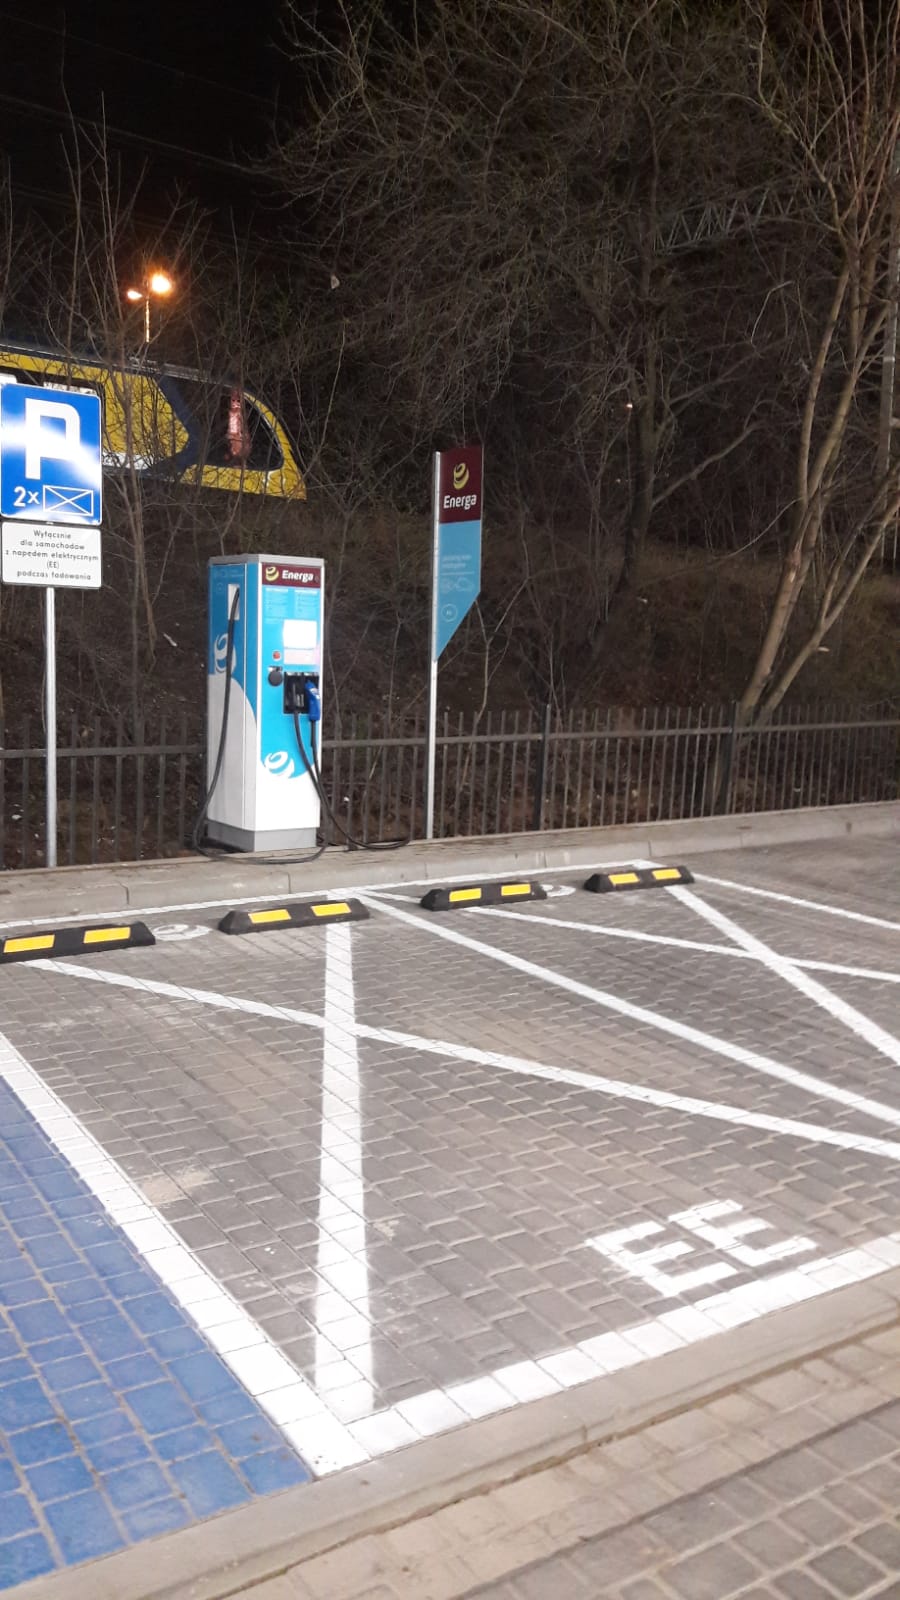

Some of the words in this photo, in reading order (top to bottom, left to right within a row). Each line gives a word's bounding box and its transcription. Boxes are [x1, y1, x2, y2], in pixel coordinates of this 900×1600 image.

[25, 398, 80, 480] P
[13, 485, 40, 507] 2x
[443, 494, 477, 510] Energa
[46, 560, 60, 569] (EE)
[51, 552, 99, 562] elektrycznym
[17, 570, 48, 578] podczas
[282, 569, 314, 583] Energa
[585, 1199, 819, 1297] EE
